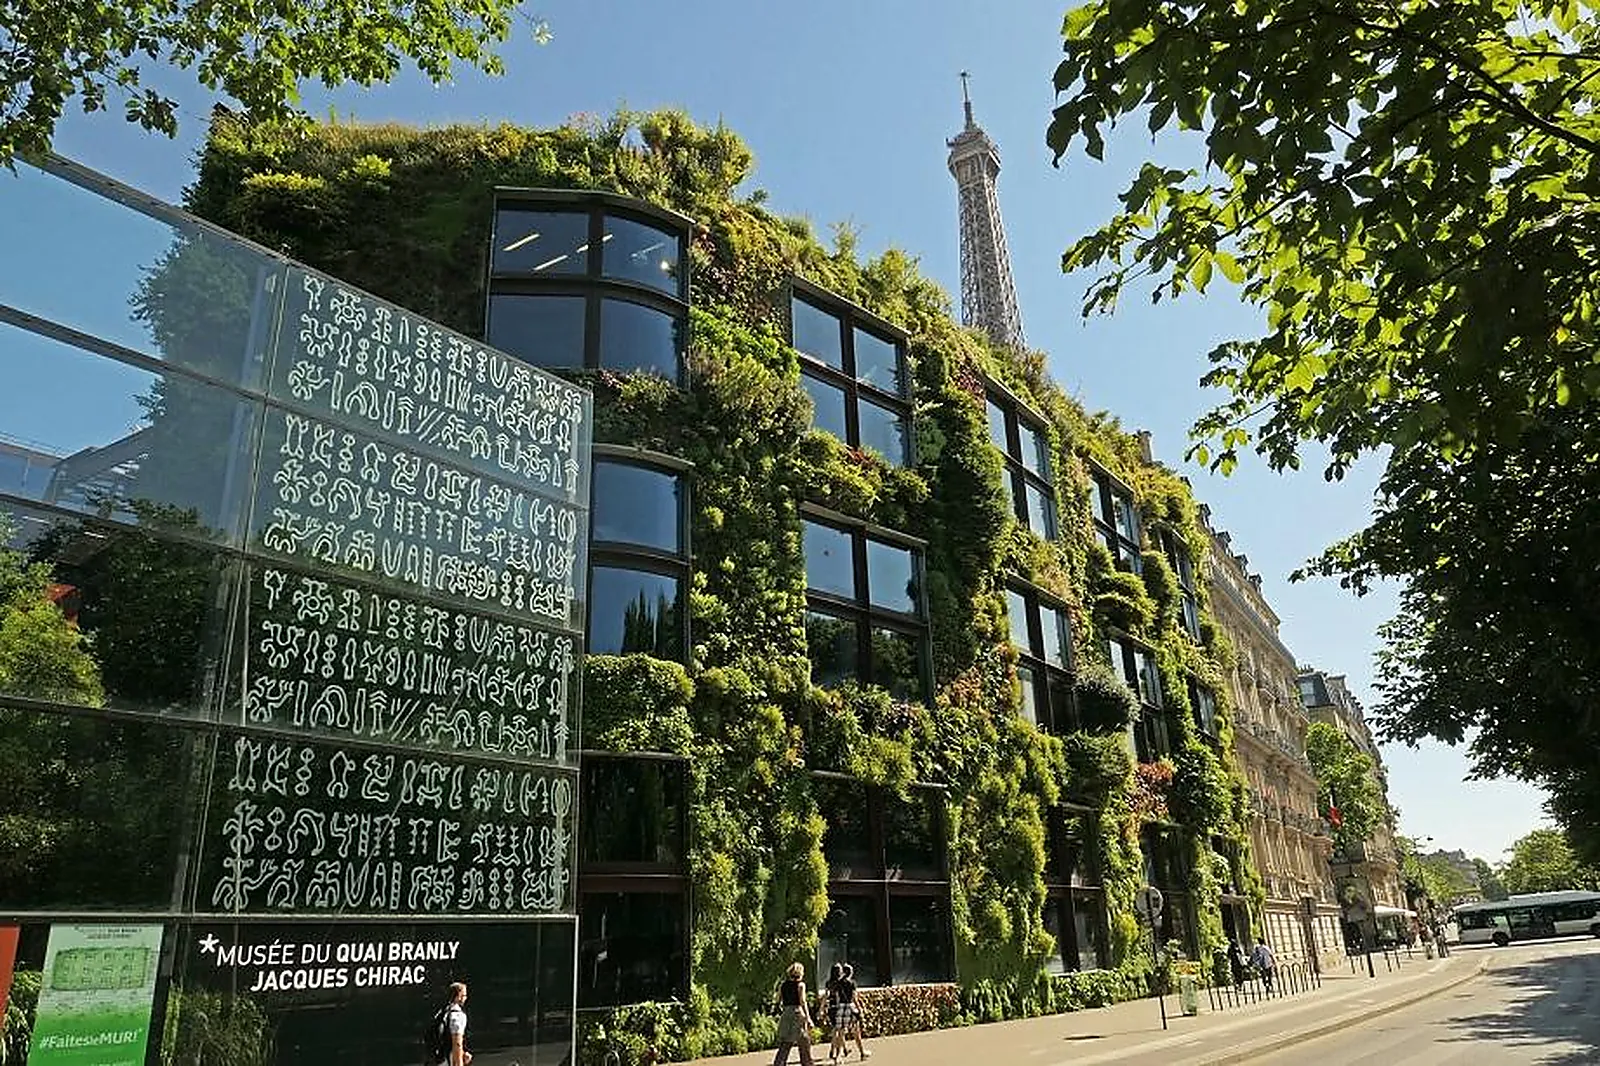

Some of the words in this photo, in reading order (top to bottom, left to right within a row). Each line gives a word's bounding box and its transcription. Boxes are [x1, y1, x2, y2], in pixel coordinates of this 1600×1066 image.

[300, 943, 332, 965] DU
[336, 942, 384, 963] QUAI
[388, 941, 460, 962] BRANLY
[250, 968, 349, 992] JACQUES
[354, 965, 426, 987] CHIRAC
